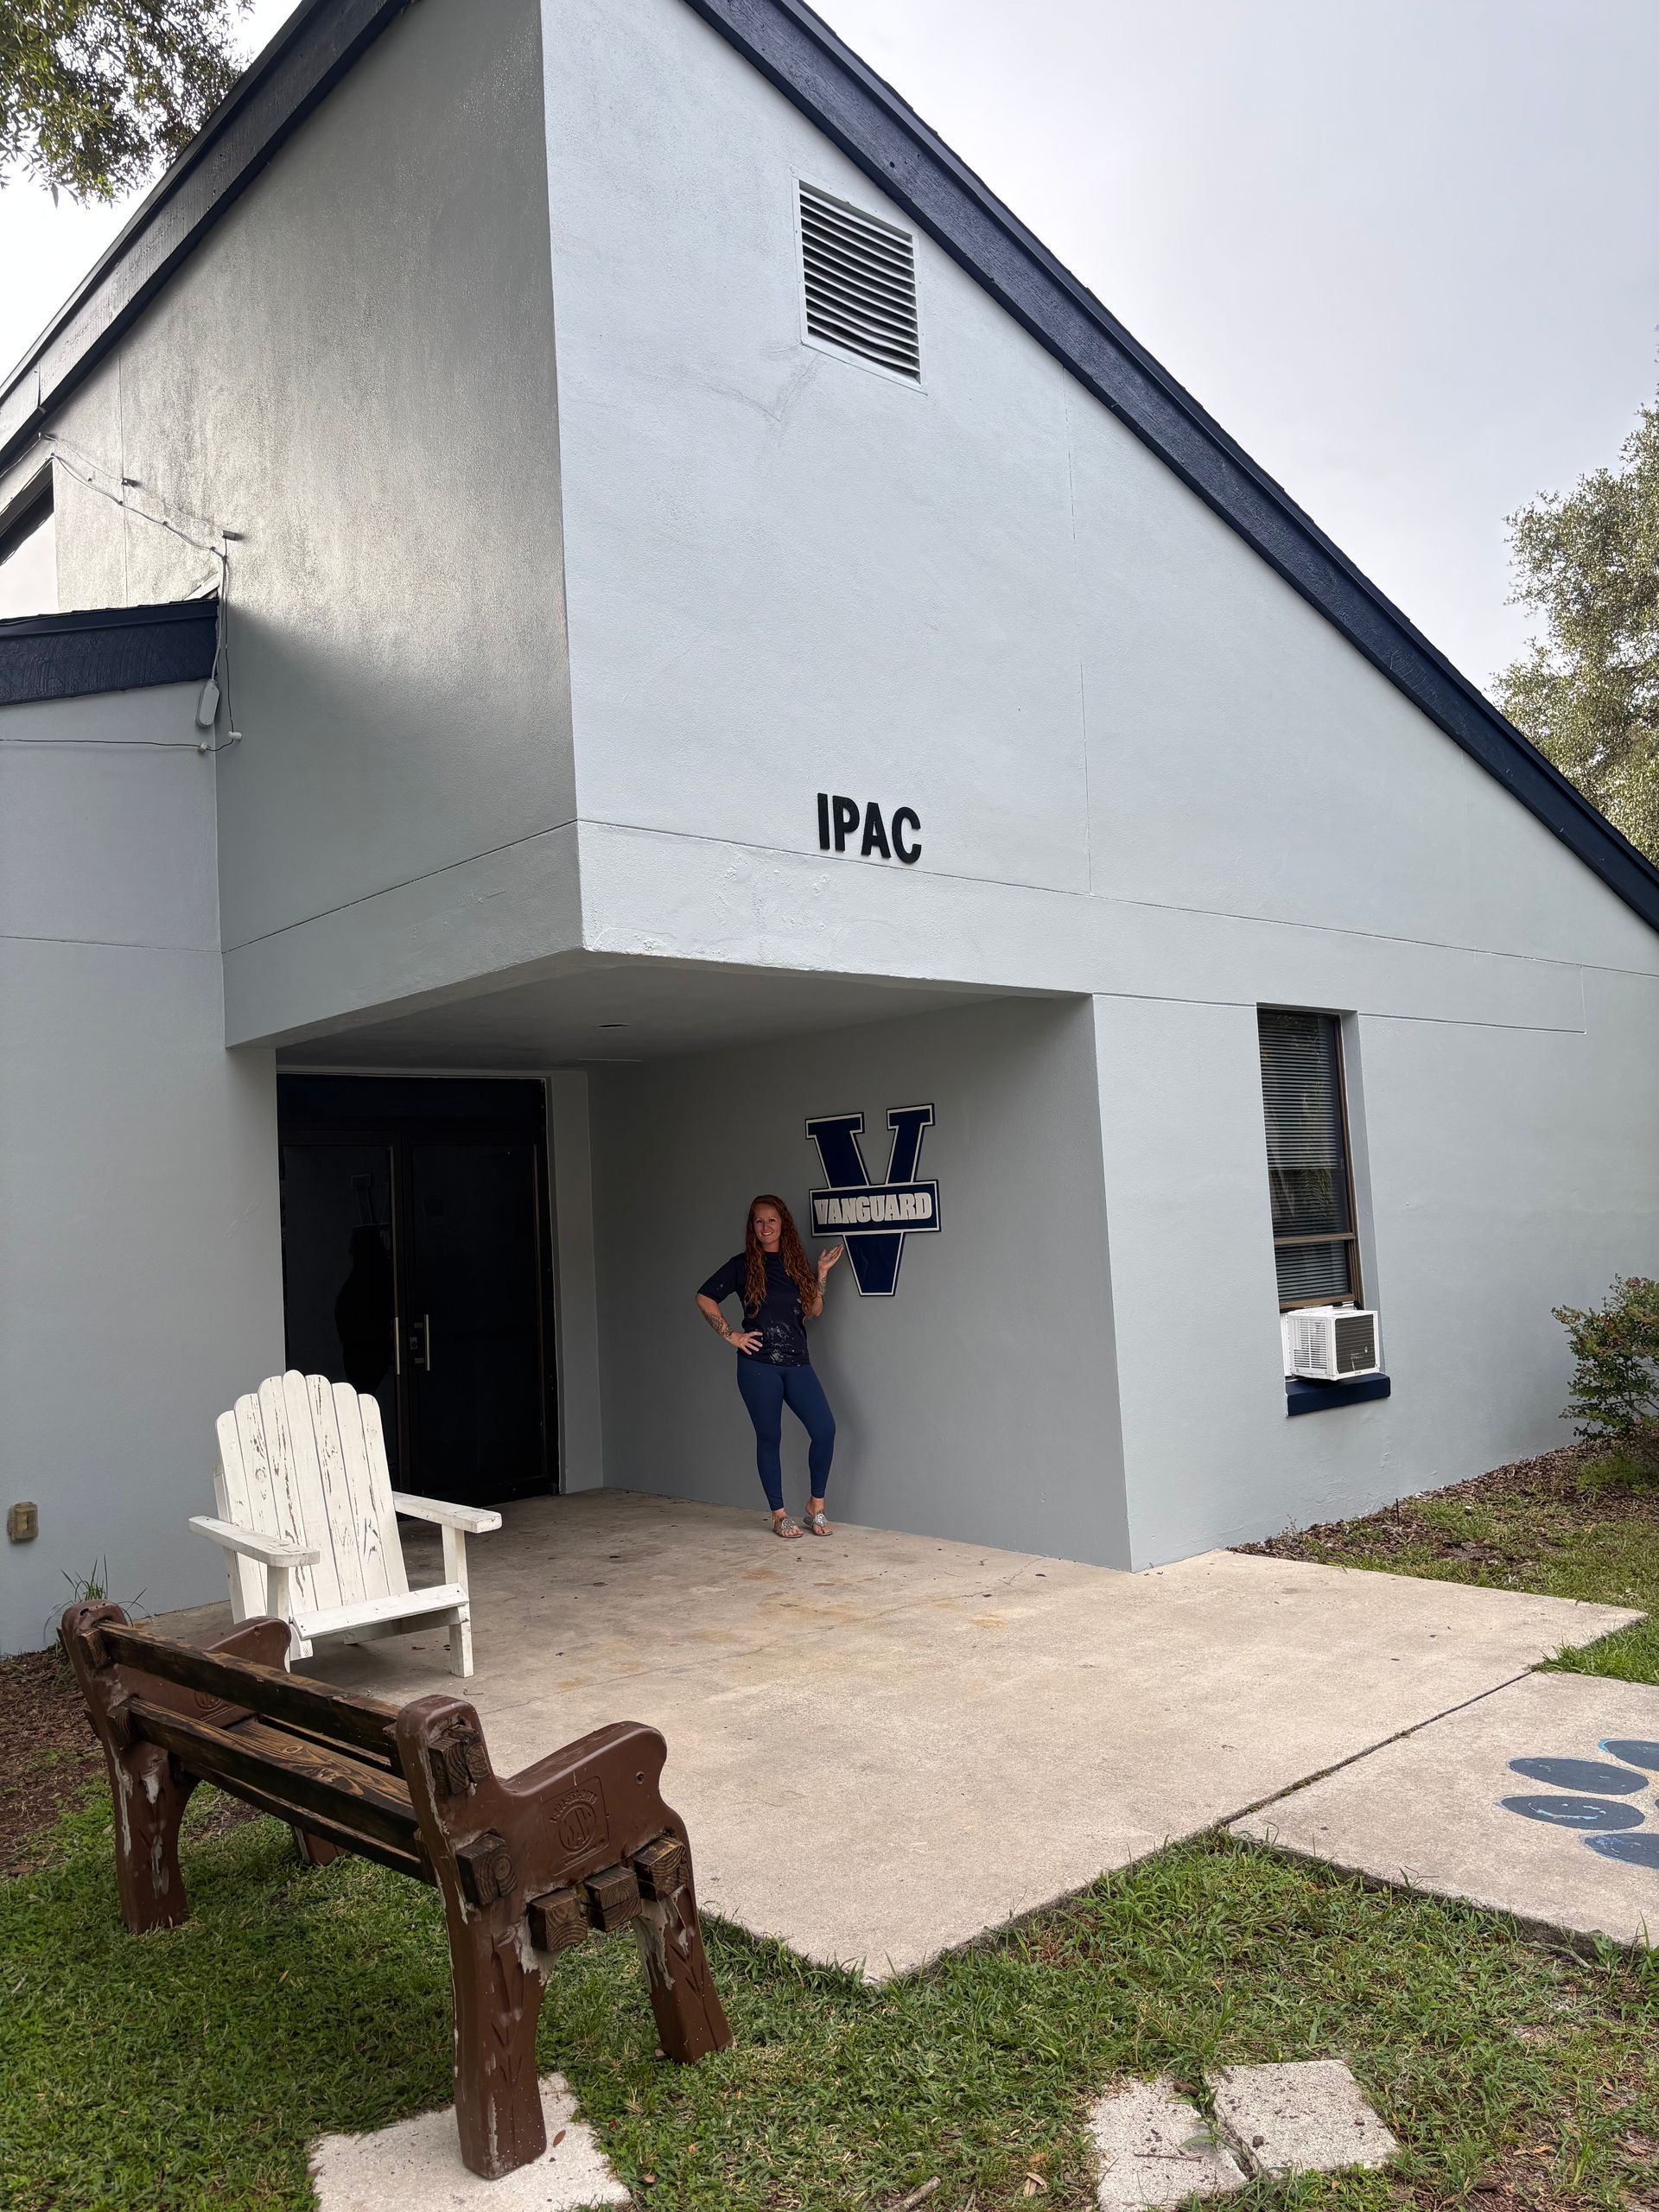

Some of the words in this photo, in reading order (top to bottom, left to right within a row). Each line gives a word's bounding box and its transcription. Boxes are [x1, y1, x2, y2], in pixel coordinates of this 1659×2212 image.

[817, 792, 922, 864] IPAC
[805, 1103, 935, 1296] V
[814, 1192, 932, 1224] VANGUARD
